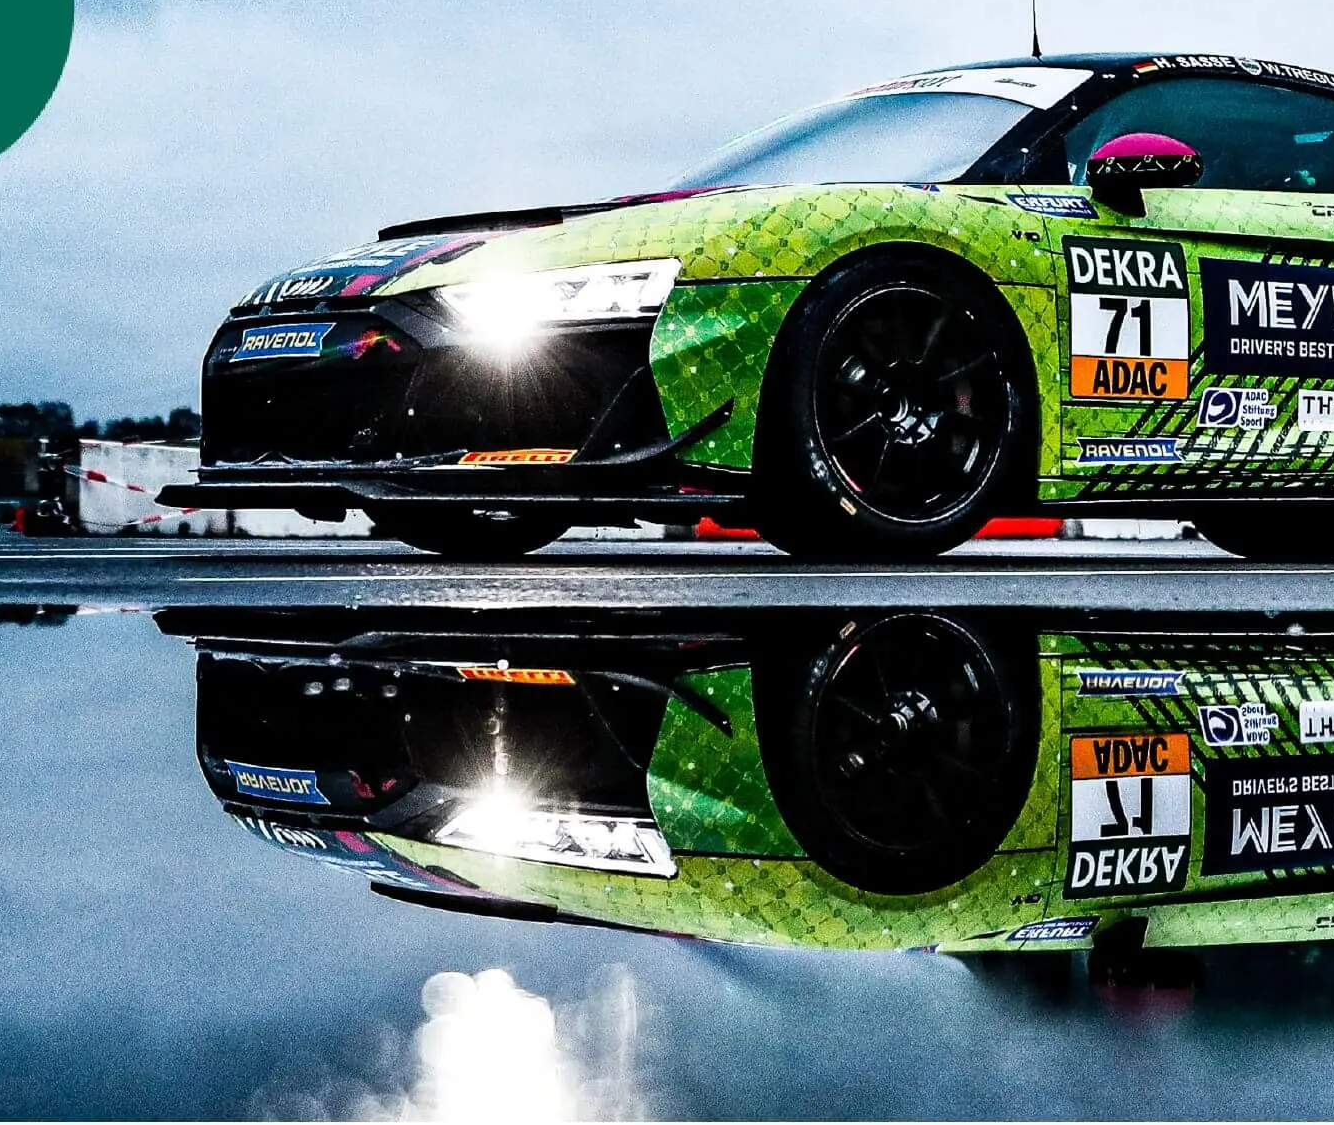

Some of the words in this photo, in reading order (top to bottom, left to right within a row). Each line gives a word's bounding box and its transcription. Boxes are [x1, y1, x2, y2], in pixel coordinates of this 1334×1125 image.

[1153, 57, 1175, 69] H.
[1176, 56, 1236, 69] SASSE
[1014, 196, 1085, 209] ERFURT
[1069, 246, 1184, 290] DEKRA
[1098, 297, 1152, 357] 71
[243, 331, 317, 351] RAVENOL
[1230, 338, 1296, 357] DRIVER'S
[1299, 341, 1334, 359] BEST
[1092, 359, 1168, 396] ADAC
[1244, 391, 1267, 402] ADAC
[1242, 404, 1276, 418] Stiftung
[1240, 416, 1266, 428] Sport
[1085, 444, 1175, 458] RAVENOL
